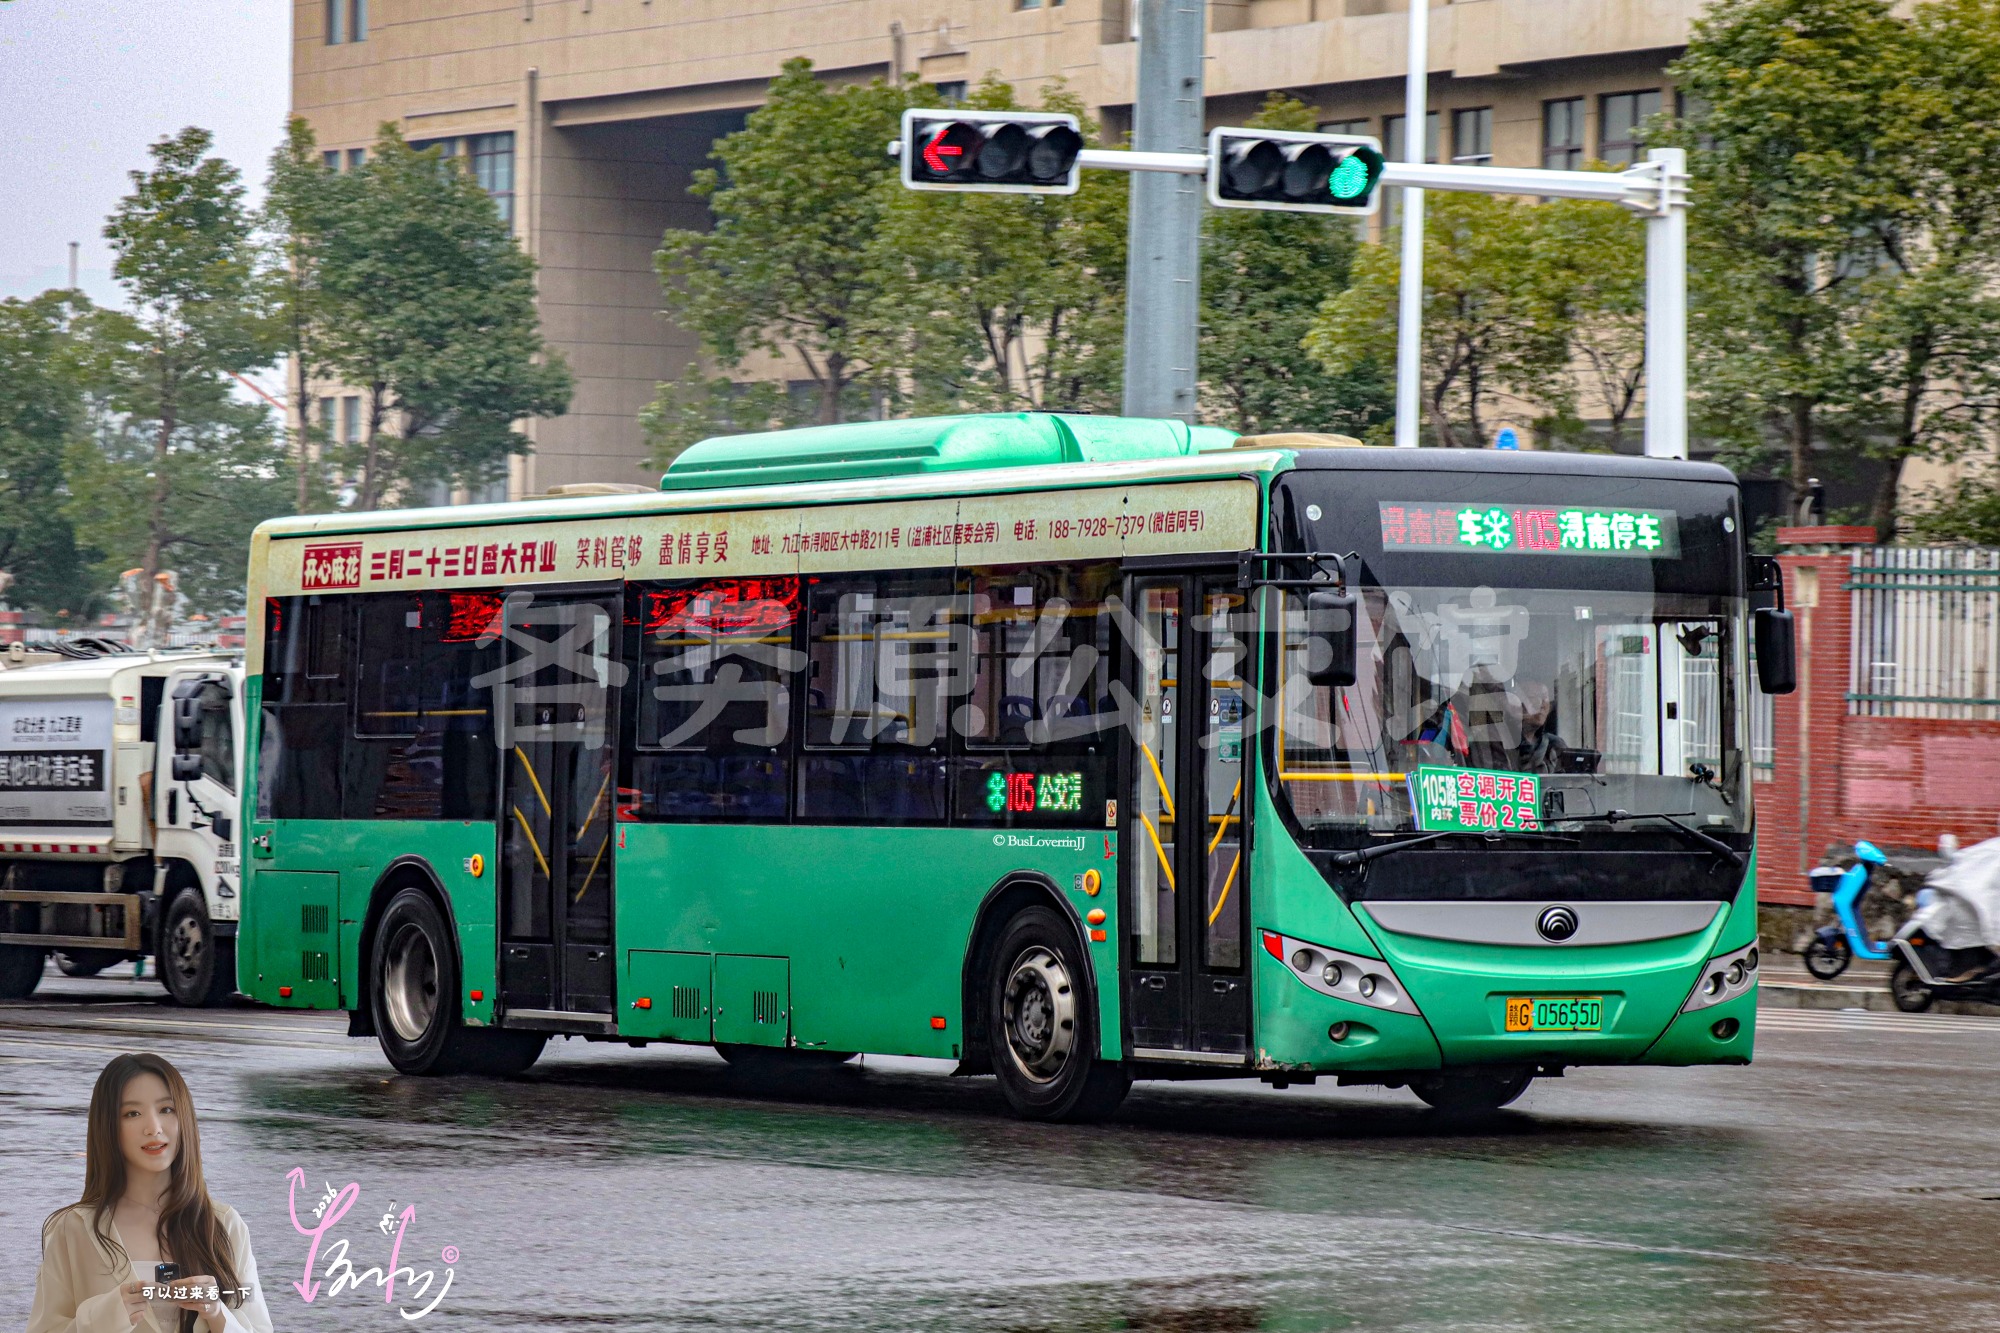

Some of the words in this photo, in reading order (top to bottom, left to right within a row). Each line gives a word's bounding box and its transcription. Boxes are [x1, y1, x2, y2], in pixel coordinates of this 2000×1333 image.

[1512, 509, 1560, 550] 105
[1558, 510, 1663, 550] 浔南停车
[370, 540, 557, 580] 三月二十三日盛大开业
[576, 534, 643, 569] 笑料管够
[659, 530, 729, 566] 盡情享受
[1006, 773, 1036, 812] 105
[1423, 774, 1458, 808] 105路
[1457, 772, 1536, 804] 空调开启
[1431, 807, 1453, 821] 内环
[1459, 801, 1539, 831] 票价2元
[1538, 1003, 1600, 1026] 05655D
